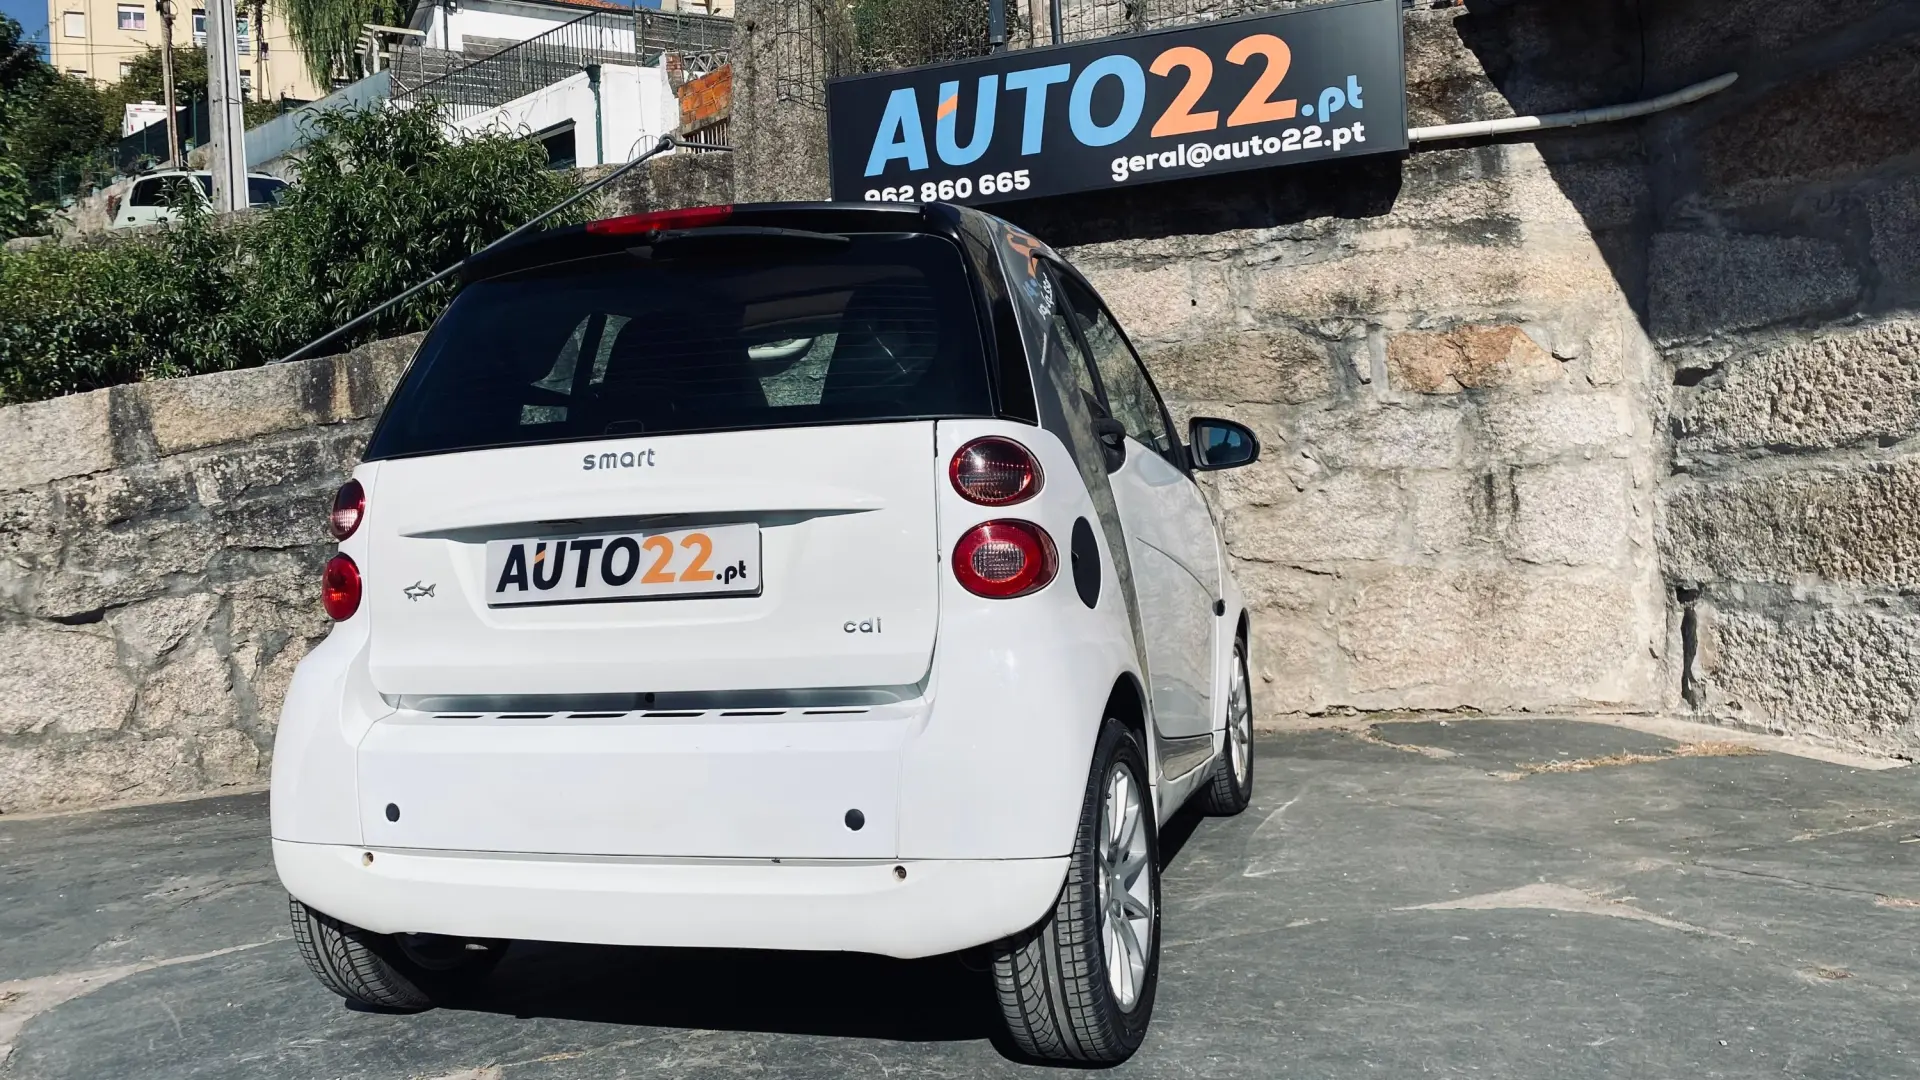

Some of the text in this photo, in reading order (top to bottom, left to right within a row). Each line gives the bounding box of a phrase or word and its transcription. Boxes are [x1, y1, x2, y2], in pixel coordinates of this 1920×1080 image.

[863, 33, 1364, 177] AUTO22.pt
[1111, 121, 1366, 182] geral@auto22.pt
[920, 177, 973, 203] 860
[978, 169, 1031, 195] 665
[583, 448, 656, 470] smart
[495, 532, 747, 593] AUTO22.pt
[843, 616, 882, 633] cdi
